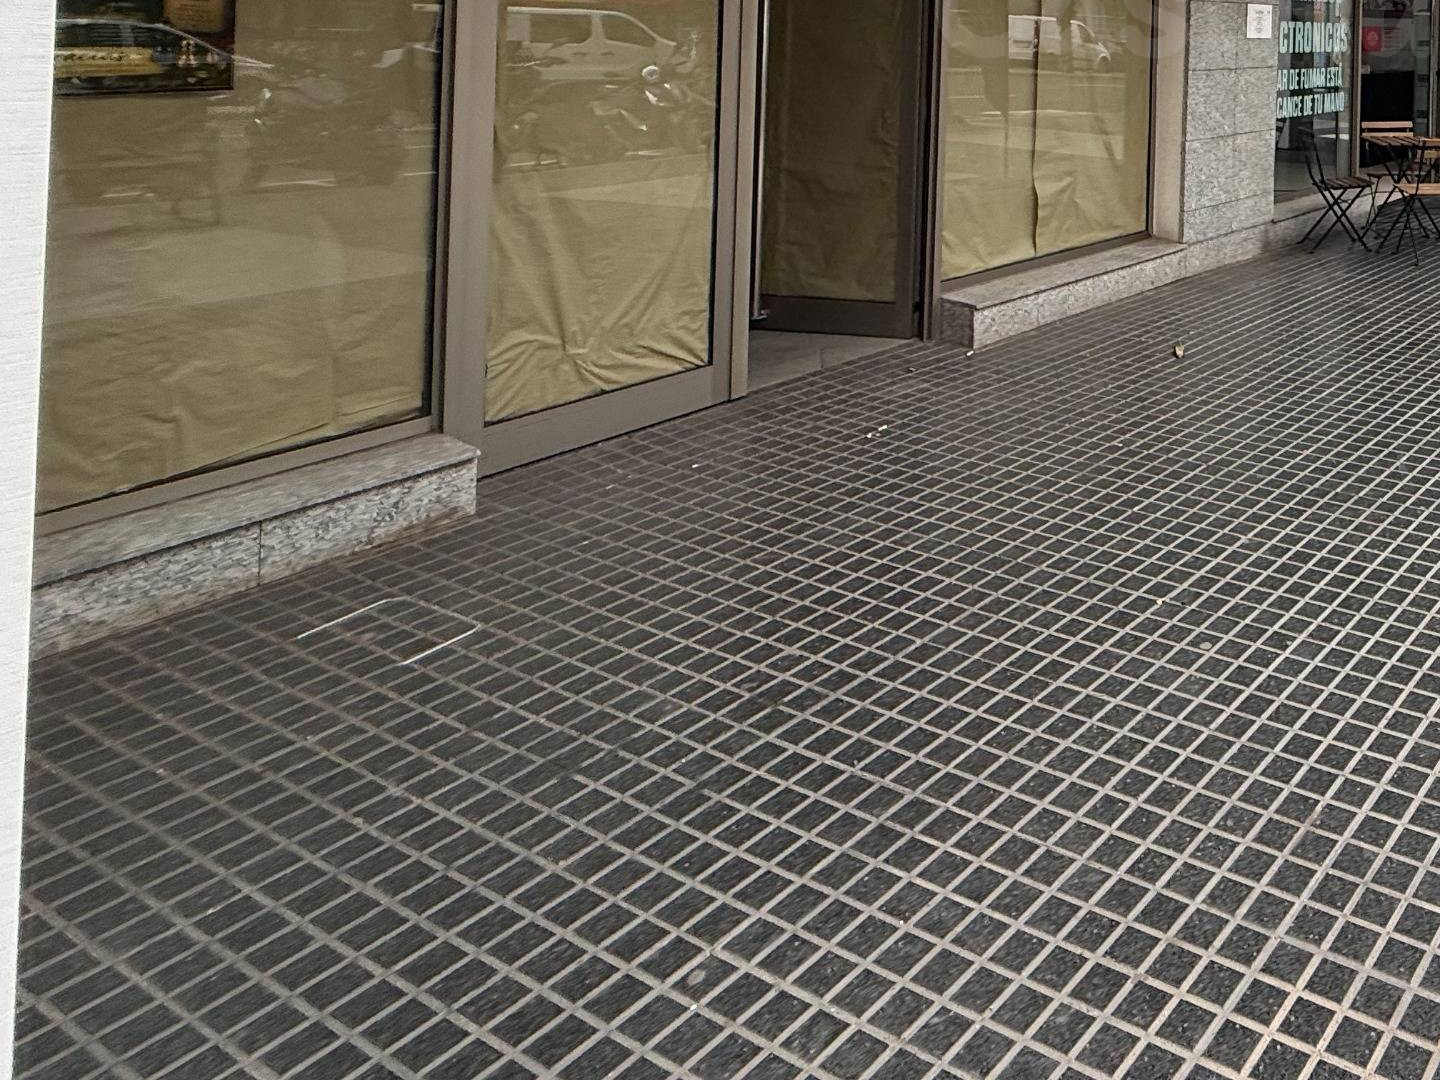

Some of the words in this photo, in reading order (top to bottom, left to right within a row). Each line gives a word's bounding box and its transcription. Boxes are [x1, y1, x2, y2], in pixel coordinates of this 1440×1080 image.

[1289, 68, 1299, 91] DE
[1300, 66, 1326, 90] FUMAR
[1276, 95, 1302, 119] CANCE
[1303, 94, 1313, 117] DE
[1314, 93, 1323, 115] TU
[1323, 91, 1345, 114] MANO
